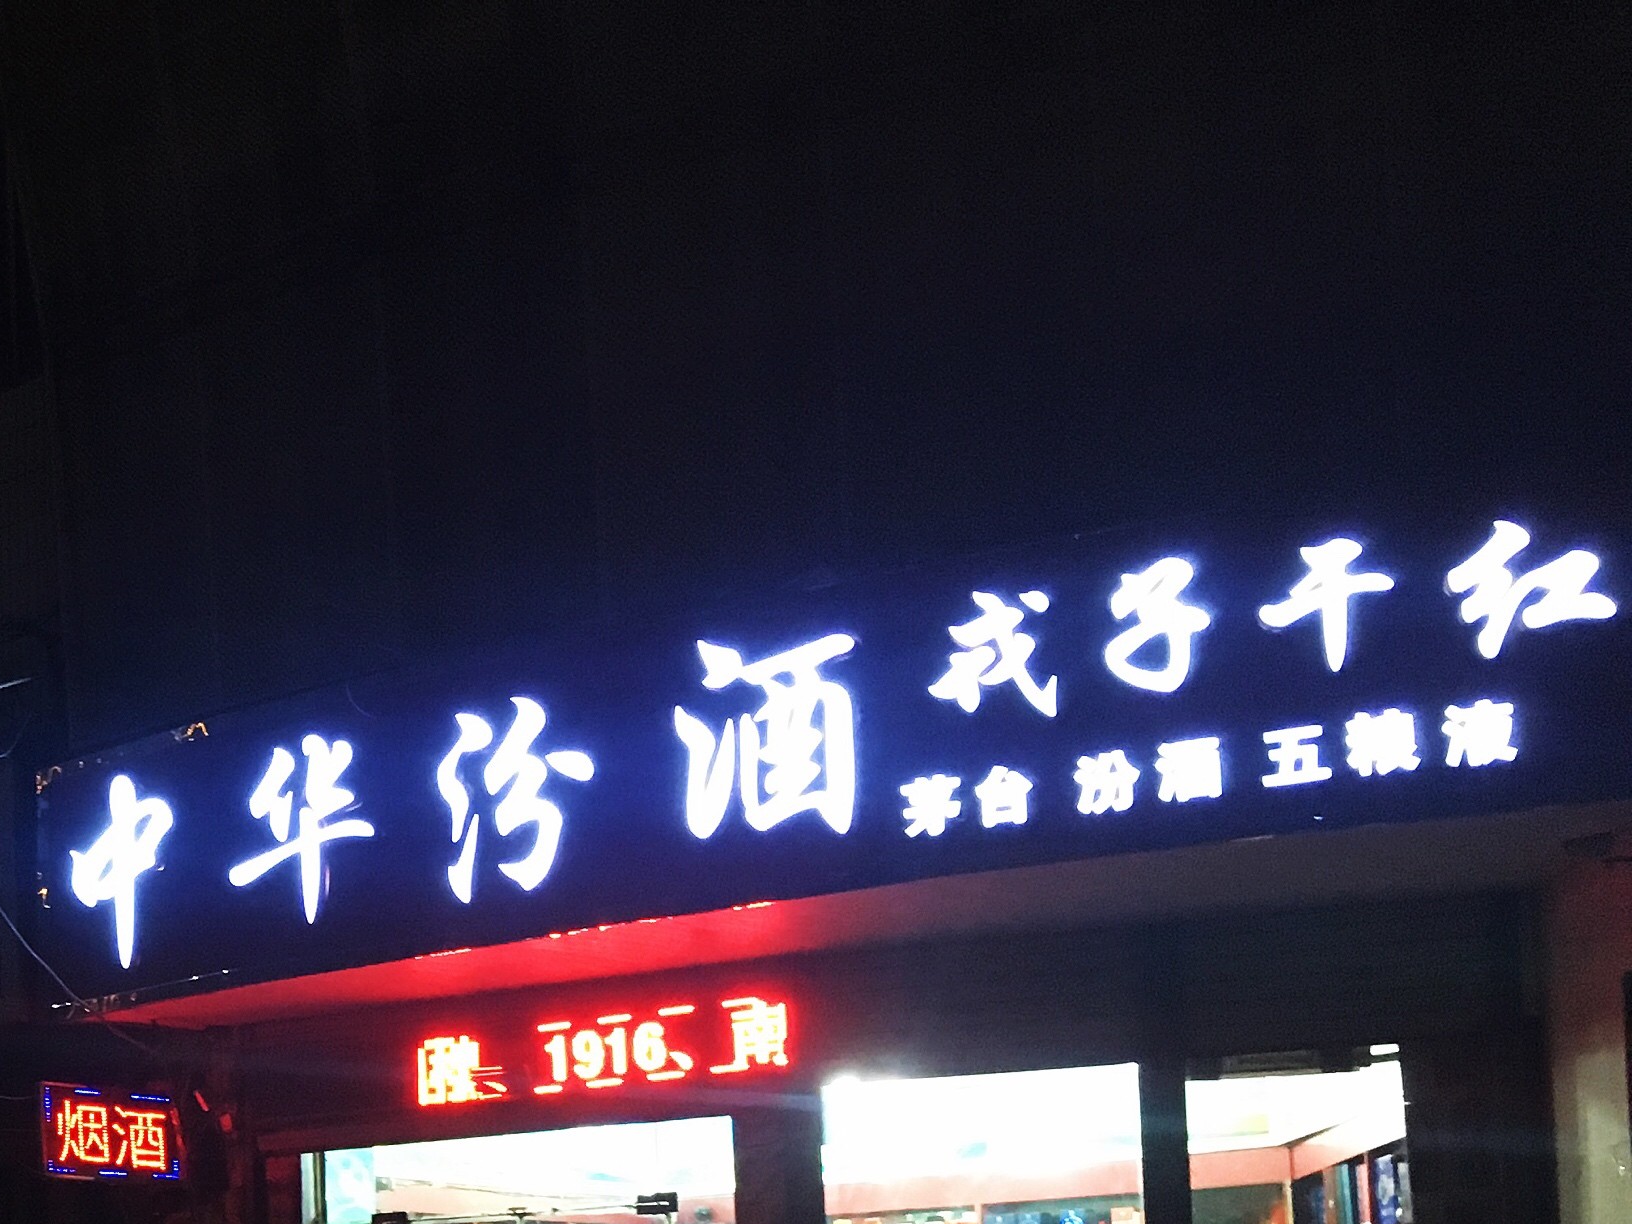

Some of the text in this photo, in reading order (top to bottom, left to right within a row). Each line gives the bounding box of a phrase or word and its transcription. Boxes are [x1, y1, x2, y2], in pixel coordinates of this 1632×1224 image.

[68, 632, 858, 970] 中华汾酒
[898, 697, 1520, 839] 茅台 汾酒 五粮液
[56, 1099, 167, 1170] 烟酒
